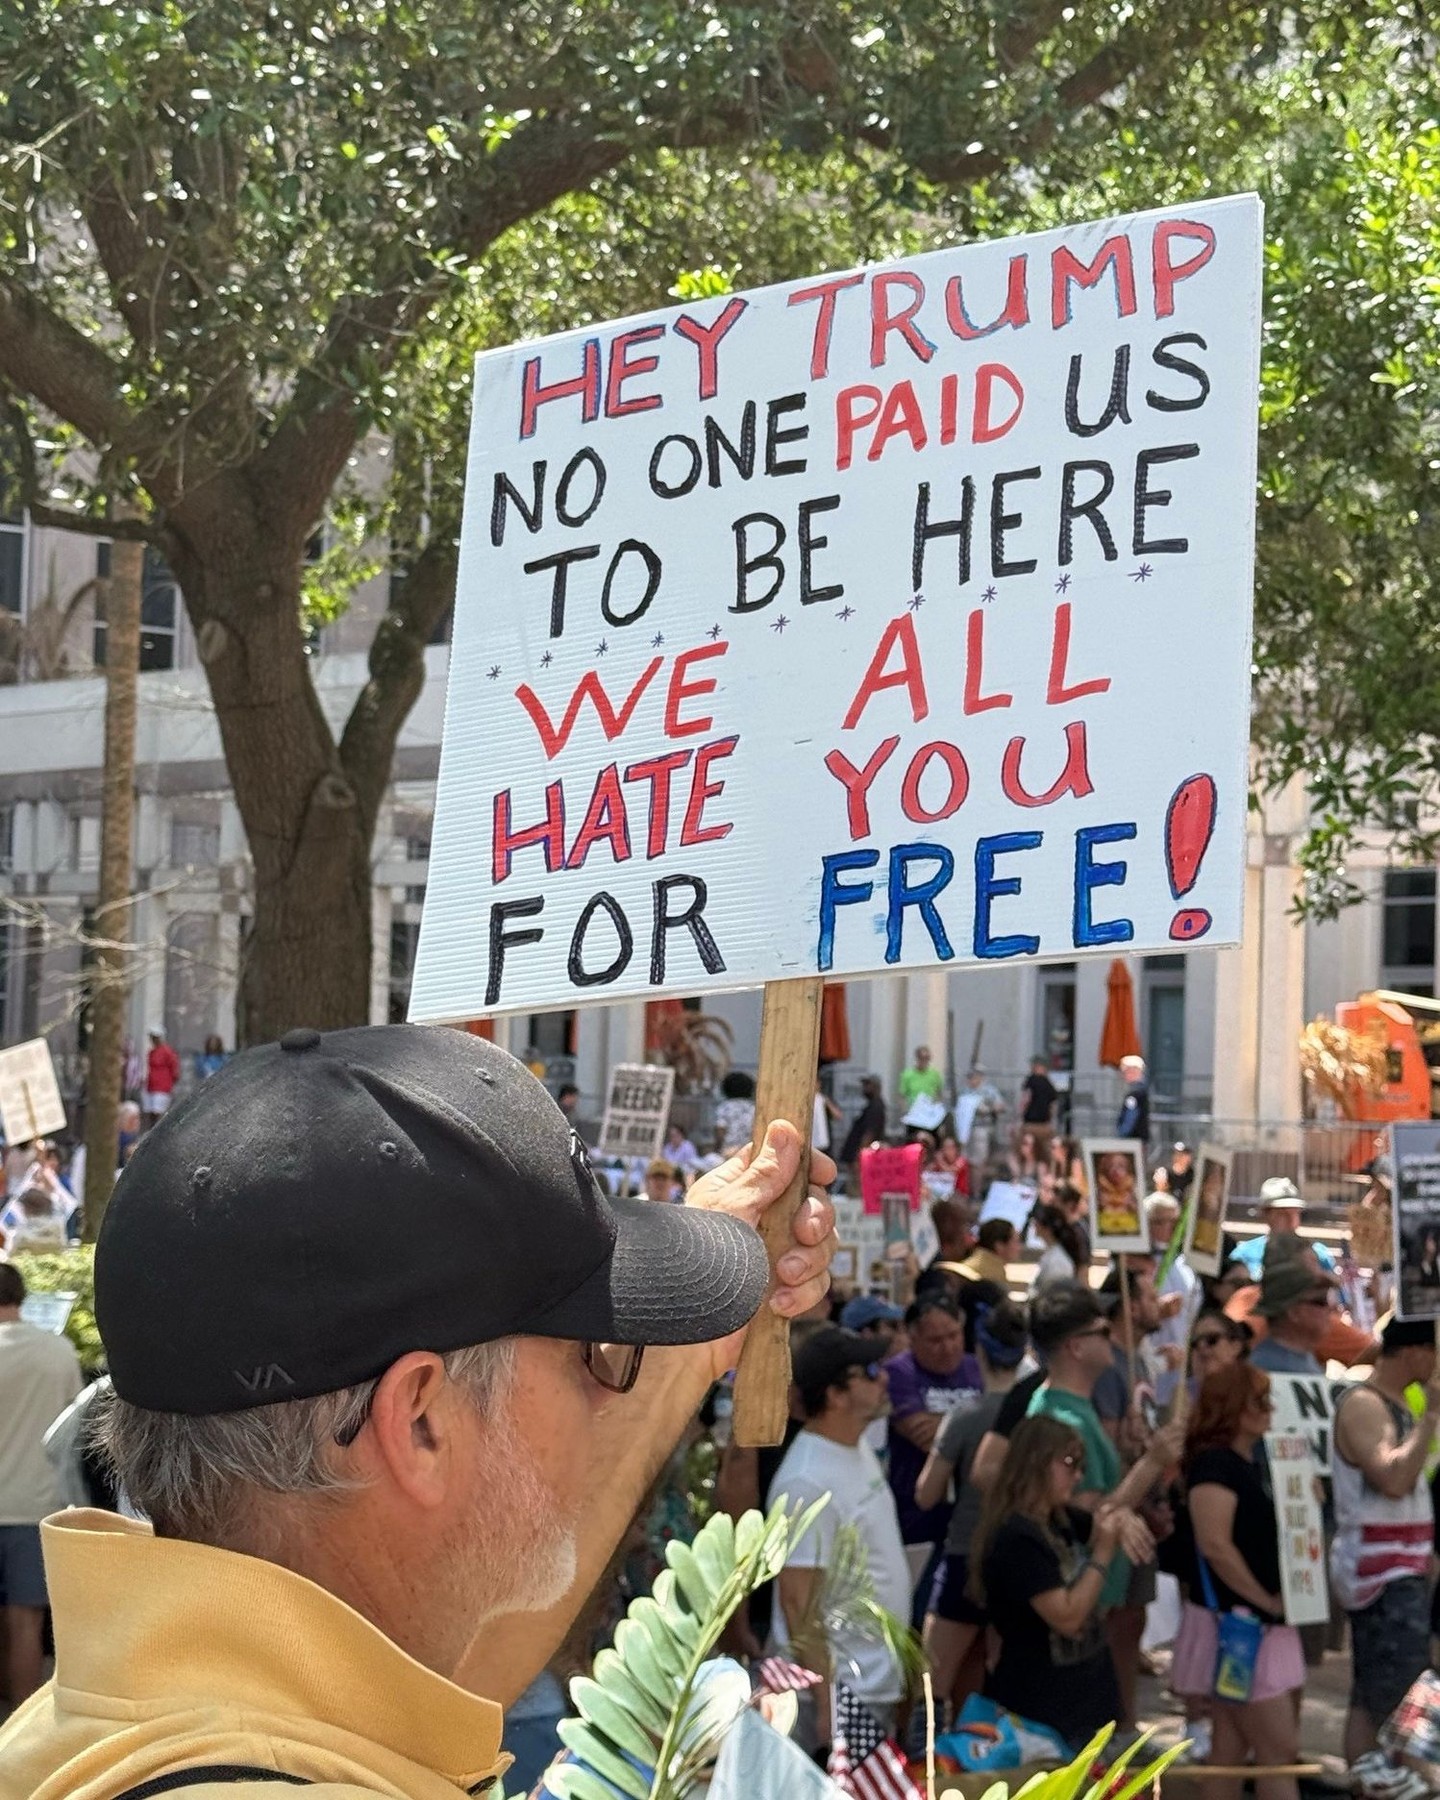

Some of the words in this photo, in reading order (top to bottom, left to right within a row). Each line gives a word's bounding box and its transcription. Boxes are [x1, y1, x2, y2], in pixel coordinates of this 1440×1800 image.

[519, 297, 748, 441] HEY
[787, 218, 1217, 382] TRUMP
[491, 446, 607, 547] NO
[648, 392, 810, 500] ONE
[835, 363, 1026, 472] PAID
[1064, 332, 1211, 438] US
[523, 538, 663, 639] TO
[727, 493, 845, 614] BE
[912, 442, 1201, 593] HERE
[514, 641, 730, 762] WE
[841, 601, 1112, 730] ALL
[484, 873, 727, 1006] FOR
[816, 773, 1218, 974] FREE!
[491, 734, 741, 886] HATE
[822, 720, 1096, 842] YOU
